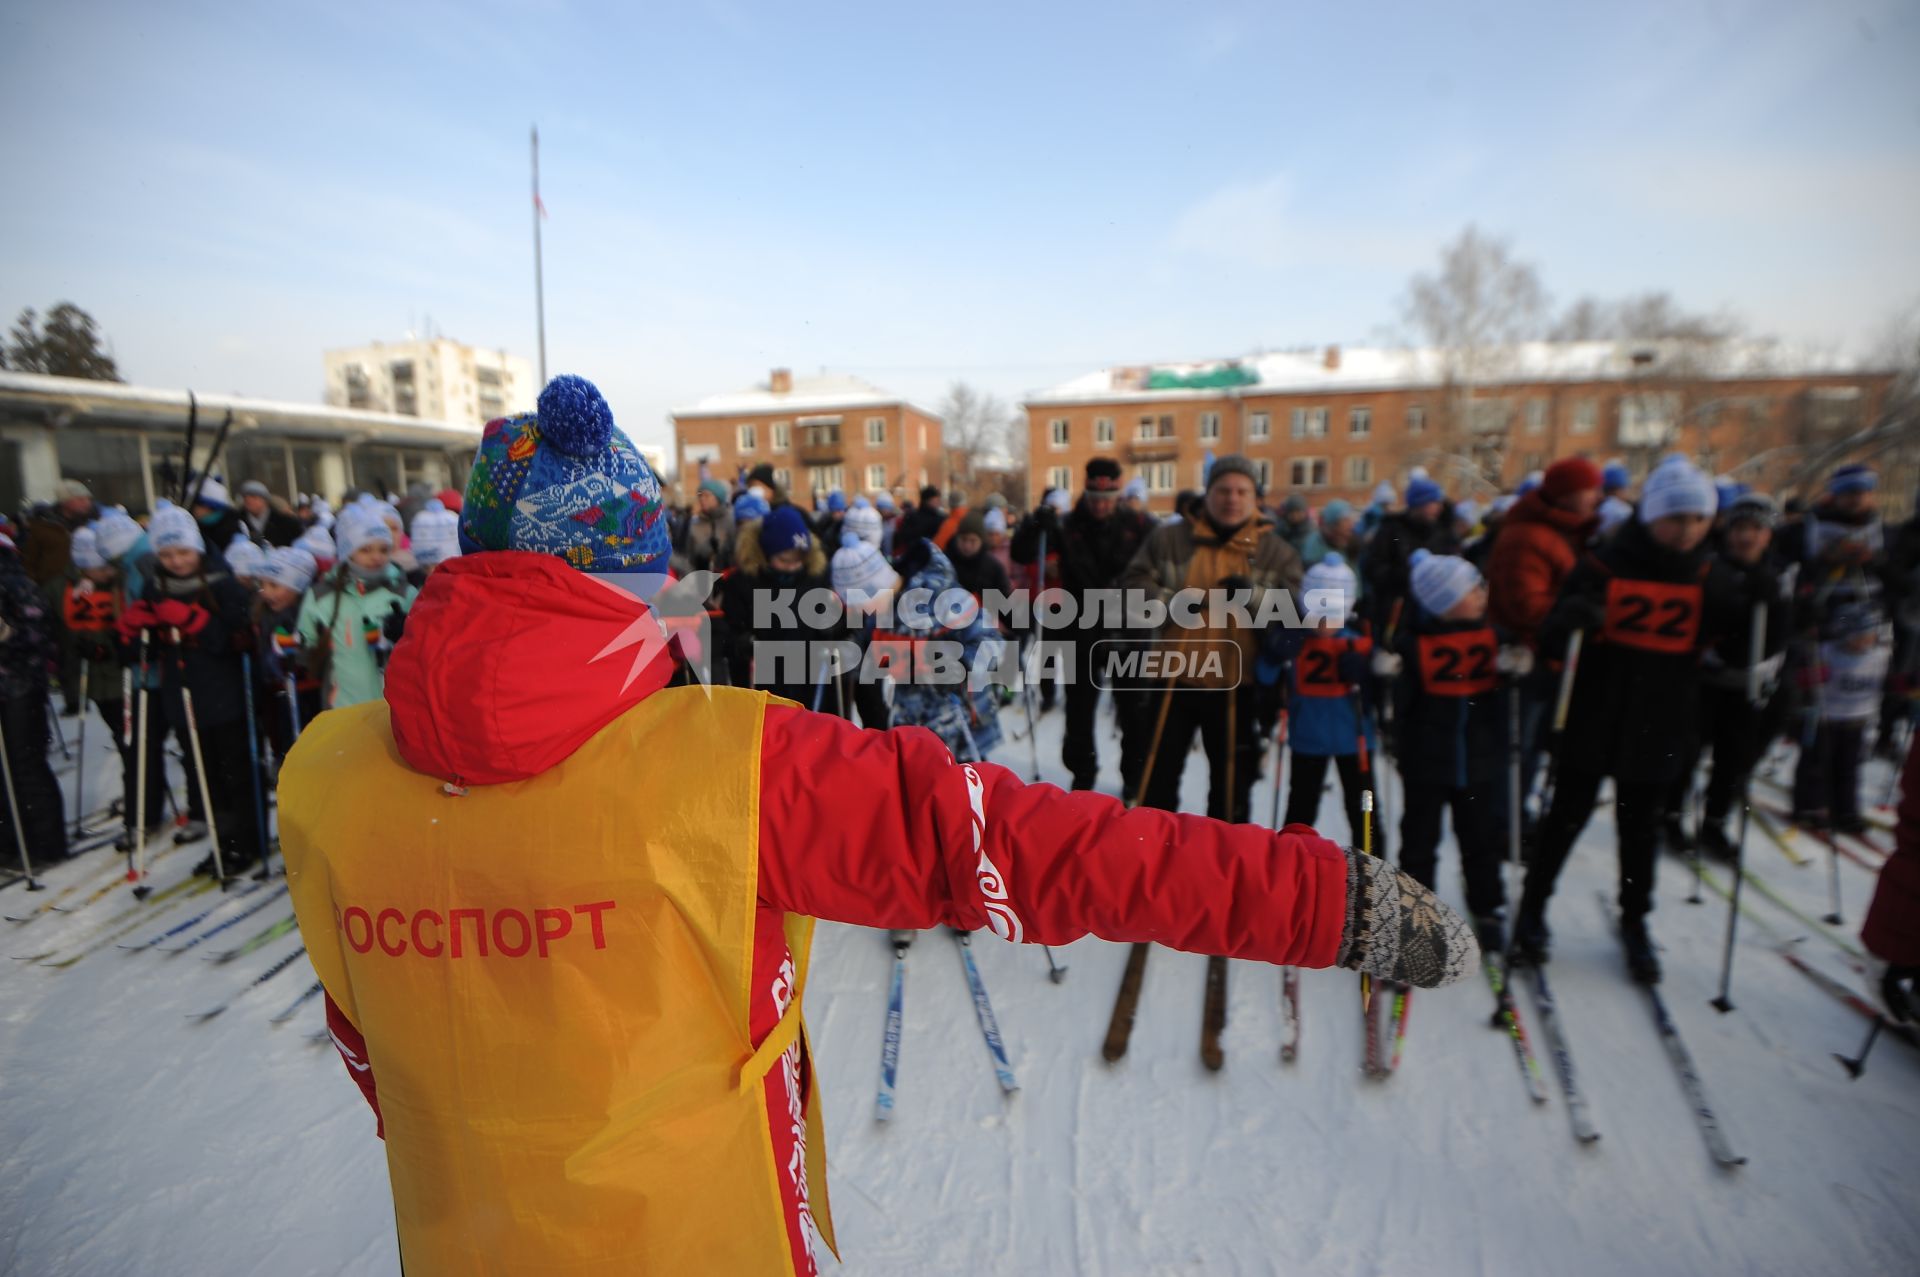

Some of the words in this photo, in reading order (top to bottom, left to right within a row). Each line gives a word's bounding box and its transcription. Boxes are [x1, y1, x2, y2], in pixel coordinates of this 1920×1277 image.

[1616, 595, 1692, 638] 22
[1305, 651, 1345, 685] 2
[1432, 645, 1494, 682] 22
[336, 900, 616, 958] ОССПОРТ
